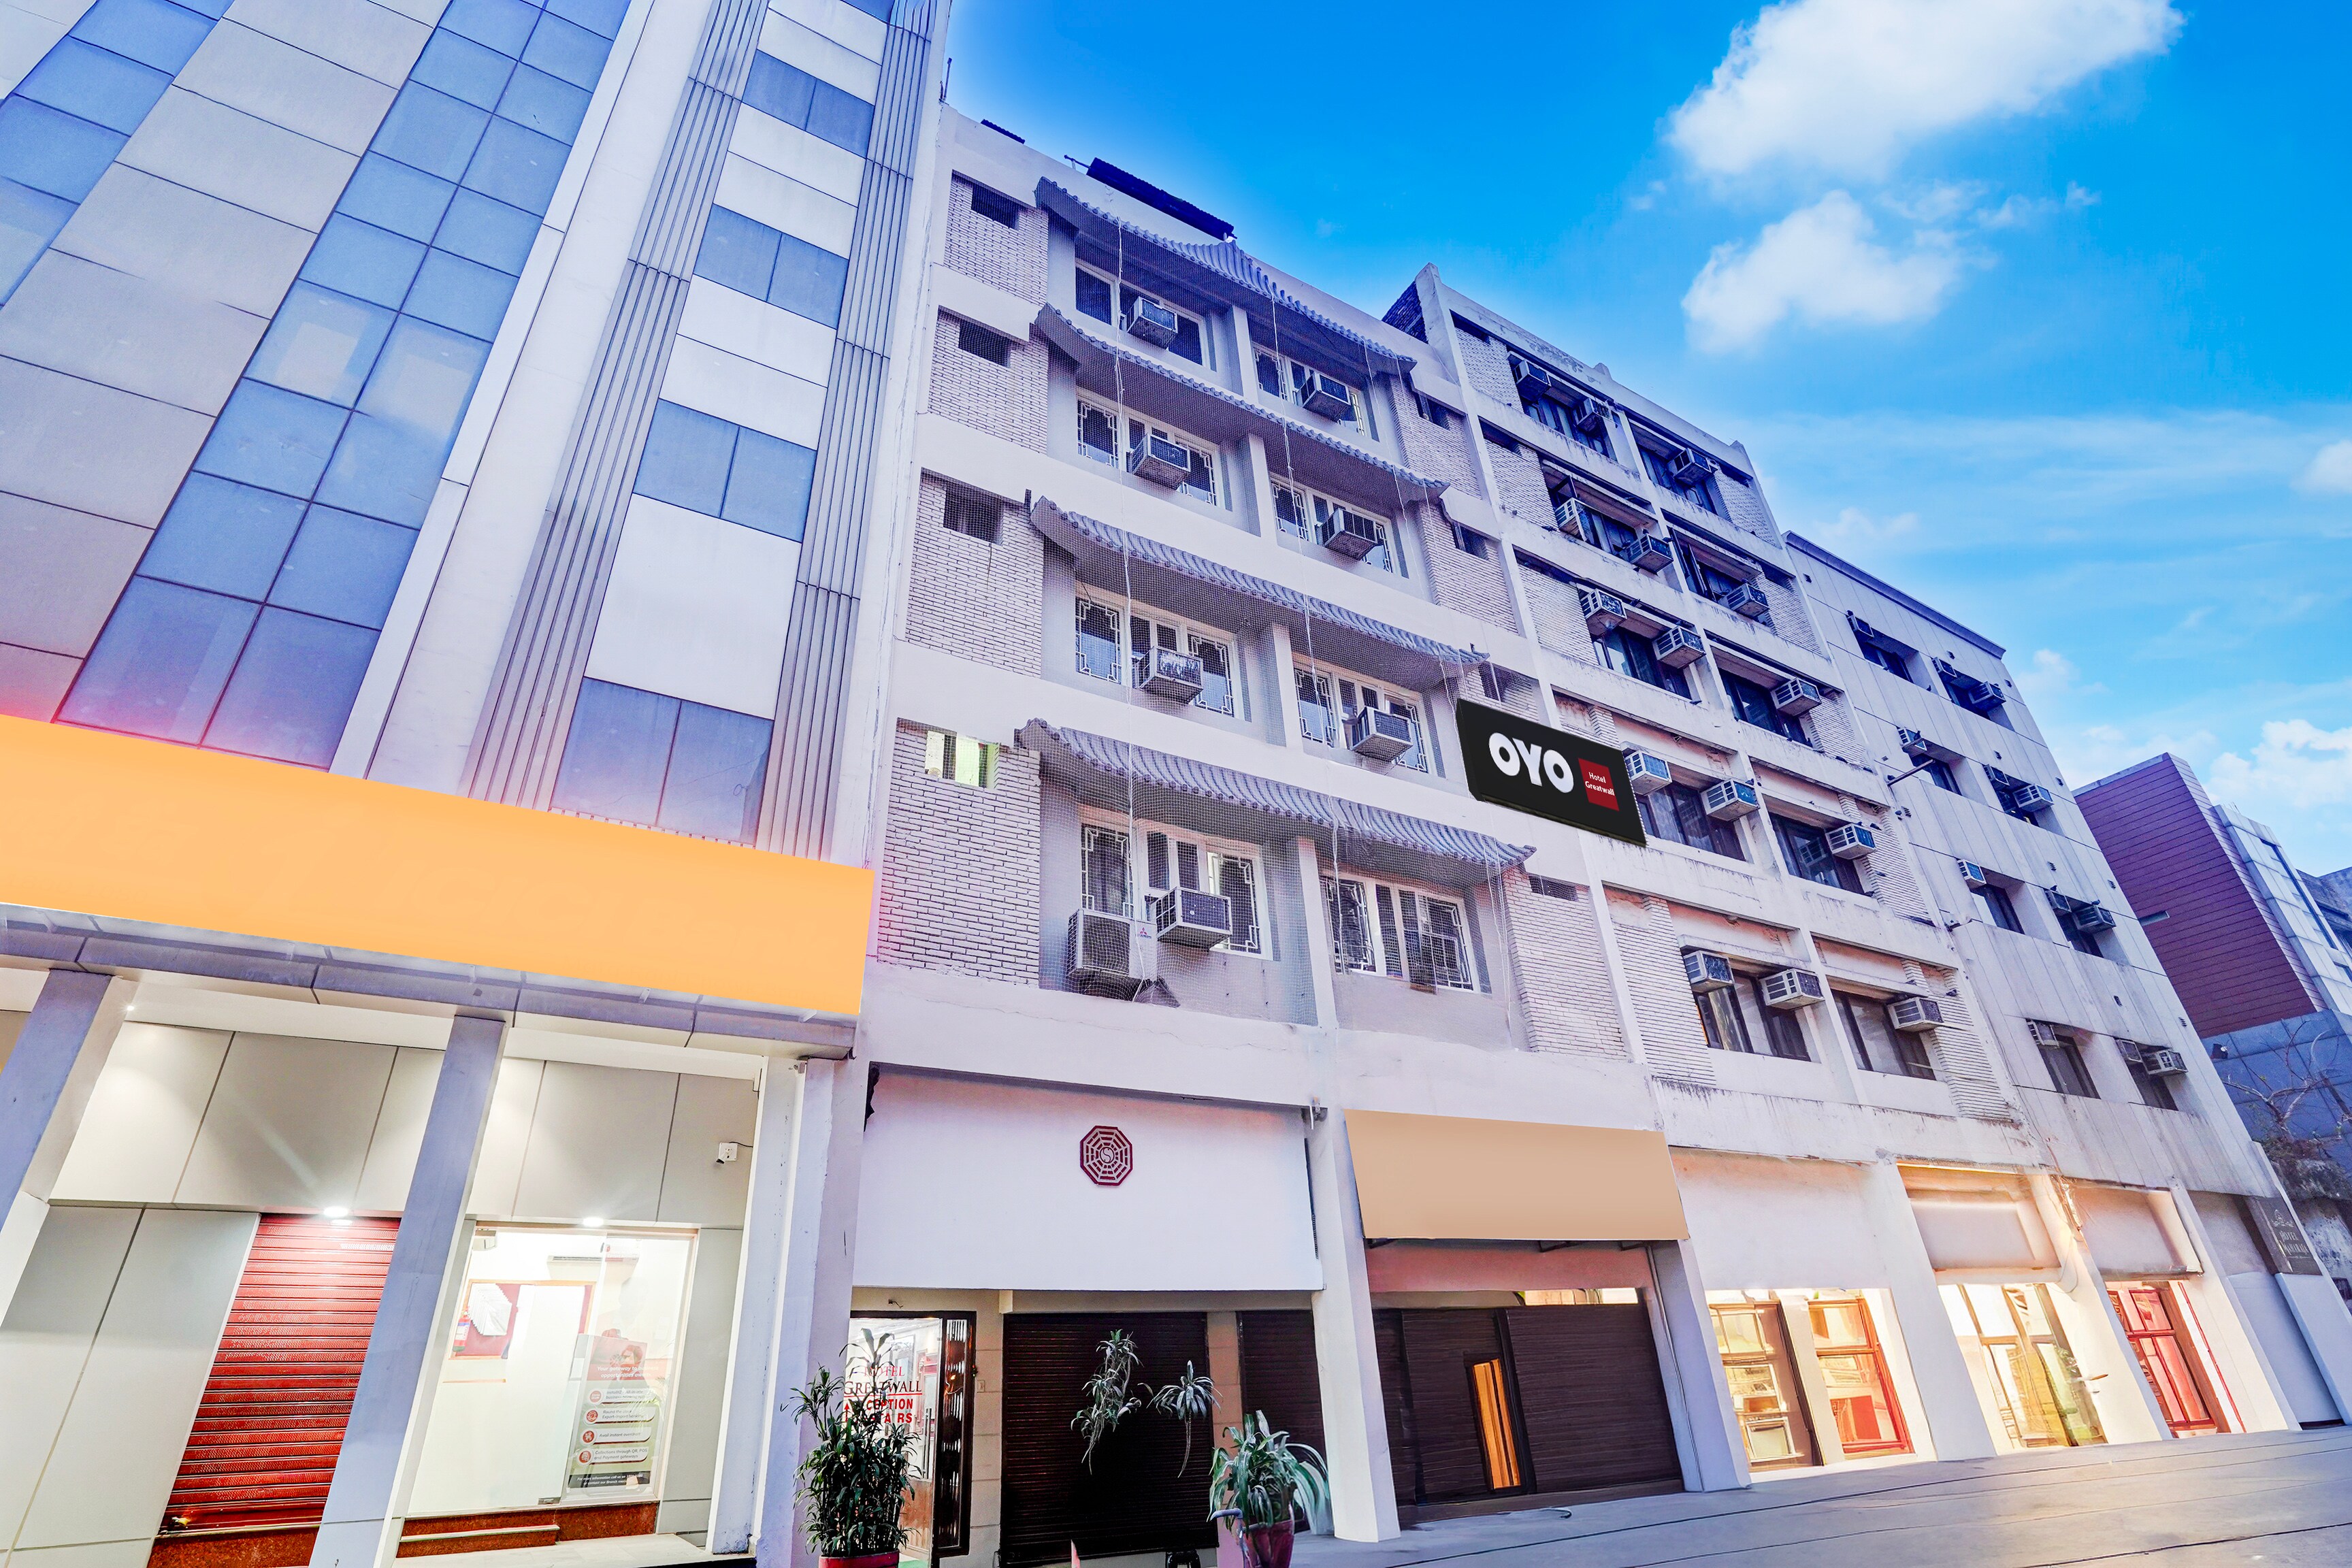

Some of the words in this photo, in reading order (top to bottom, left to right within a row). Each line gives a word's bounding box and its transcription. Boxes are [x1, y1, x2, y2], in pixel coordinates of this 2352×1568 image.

[1489, 732, 1574, 794] OYO
[1588, 771, 1606, 783] Hotel
[1585, 781, 1615, 796] Greatwall
[844, 1380, 922, 1394] GRETWALL
